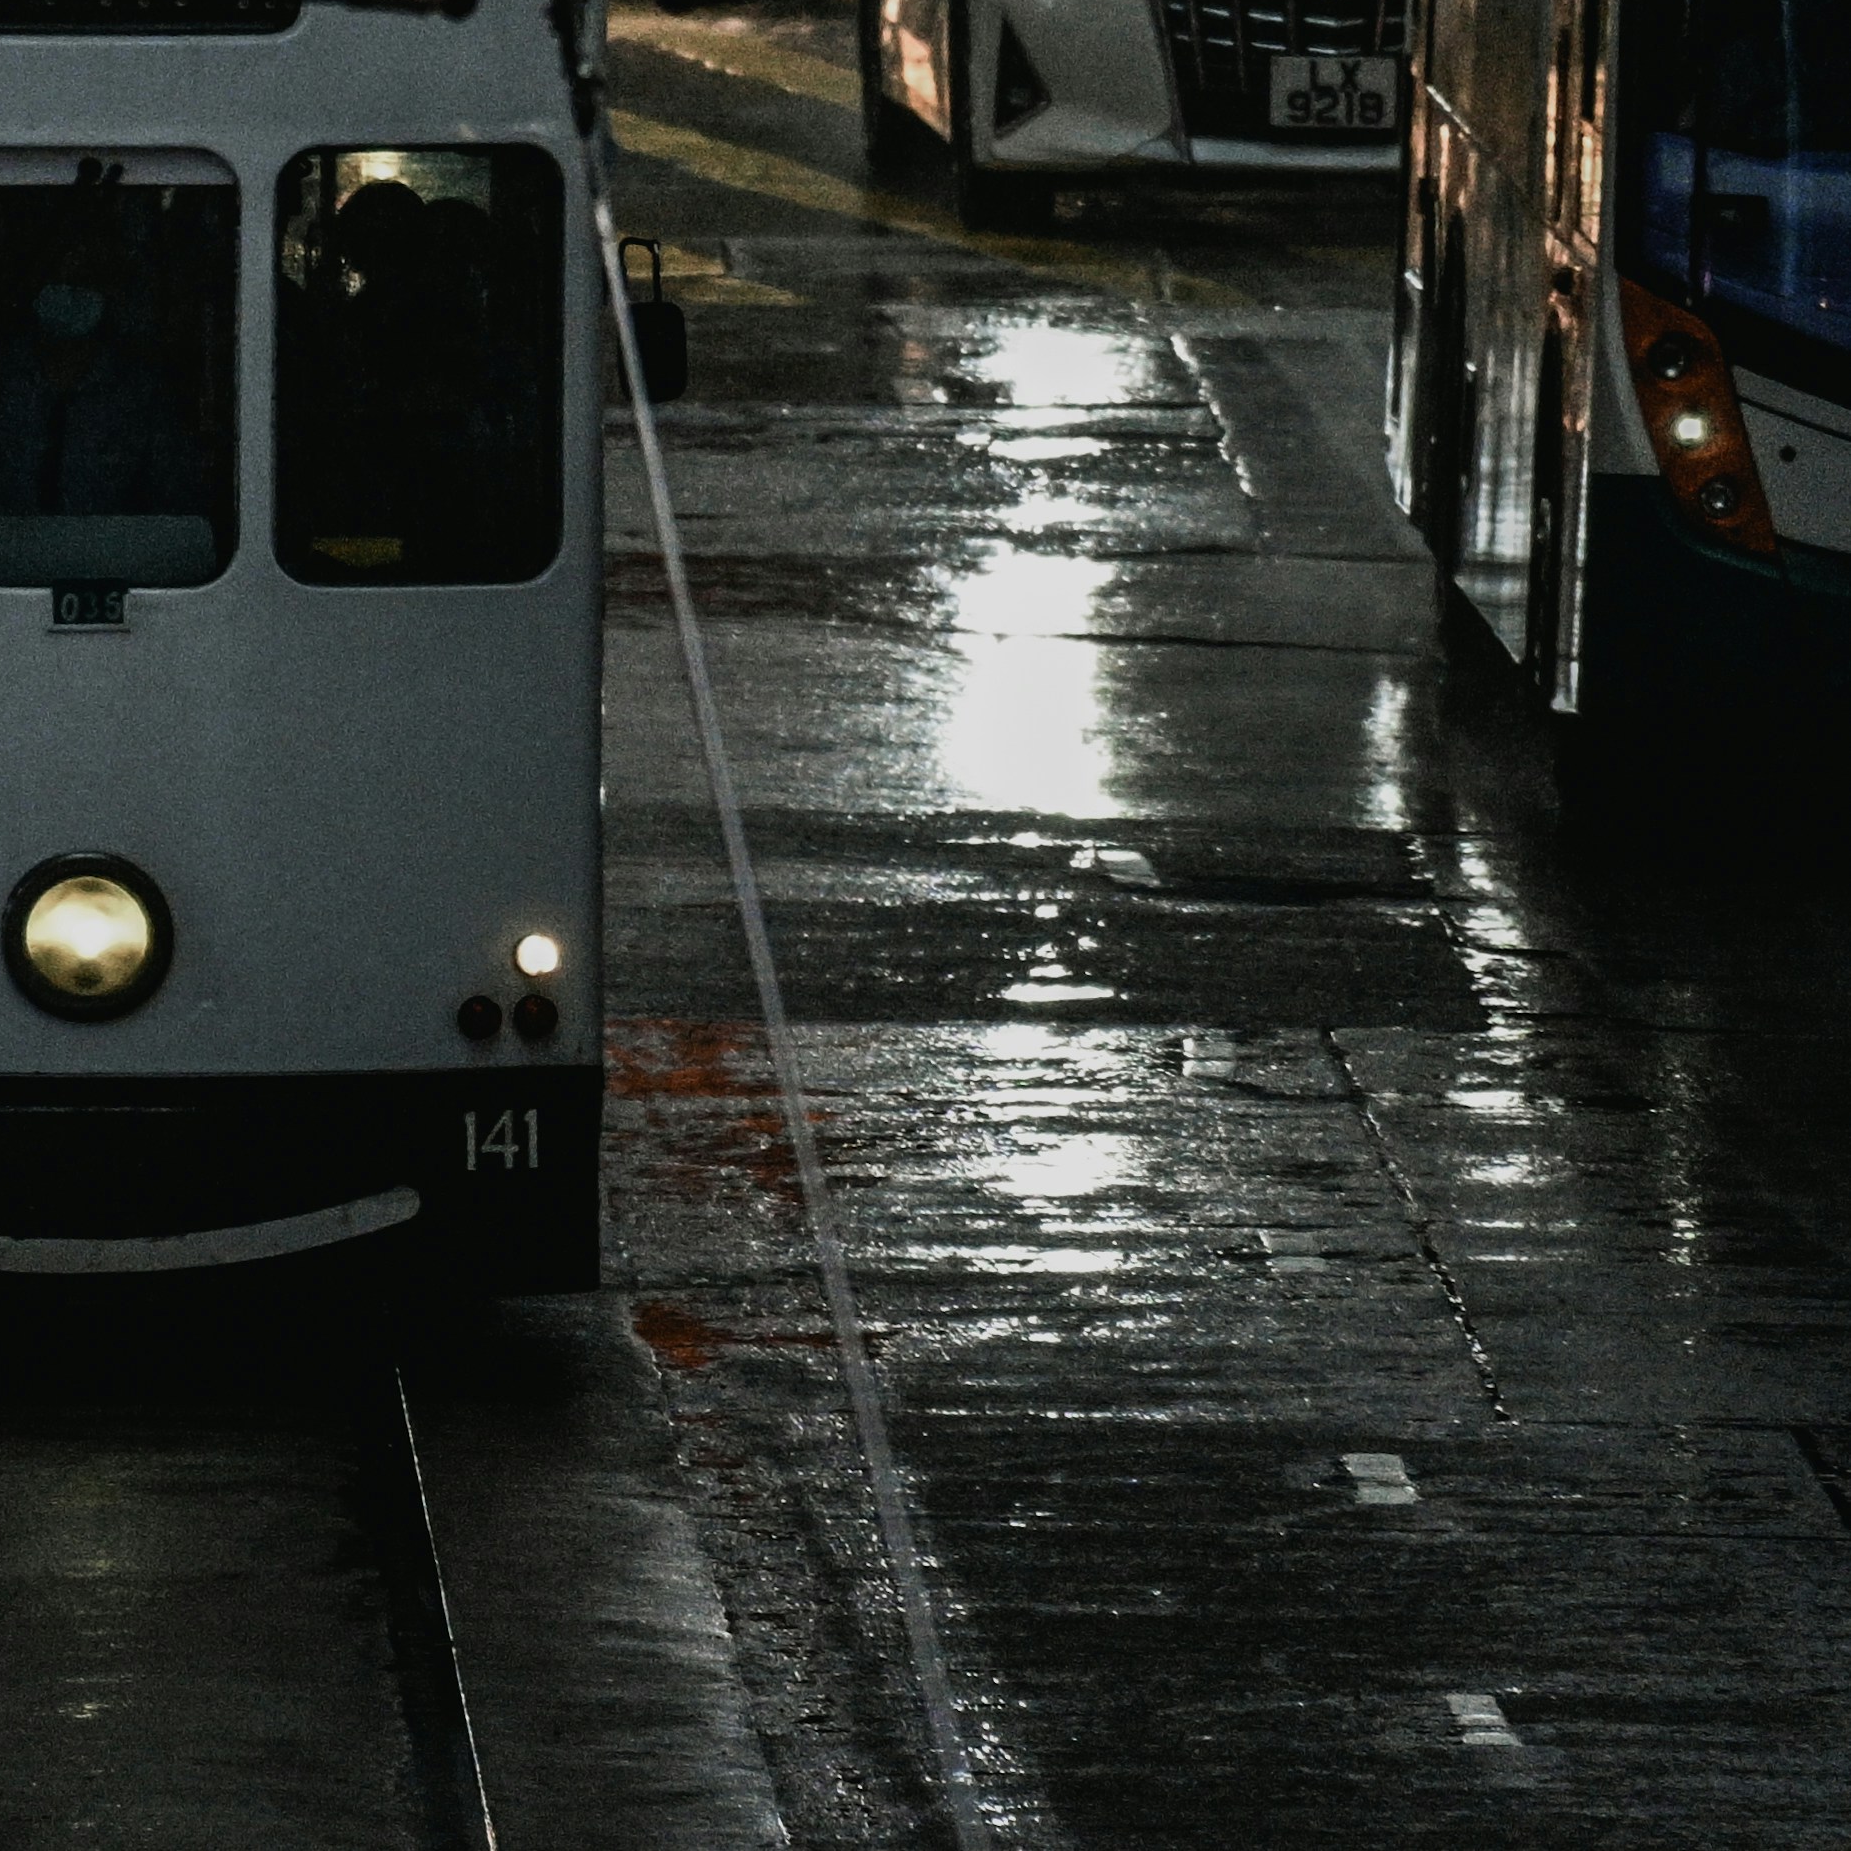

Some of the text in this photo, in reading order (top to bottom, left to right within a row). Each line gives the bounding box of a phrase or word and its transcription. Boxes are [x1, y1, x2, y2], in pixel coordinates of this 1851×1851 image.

[1309, 59, 1362, 93] LX
[1287, 90, 1384, 125] 9218
[463, 1109, 540, 1173] 141
